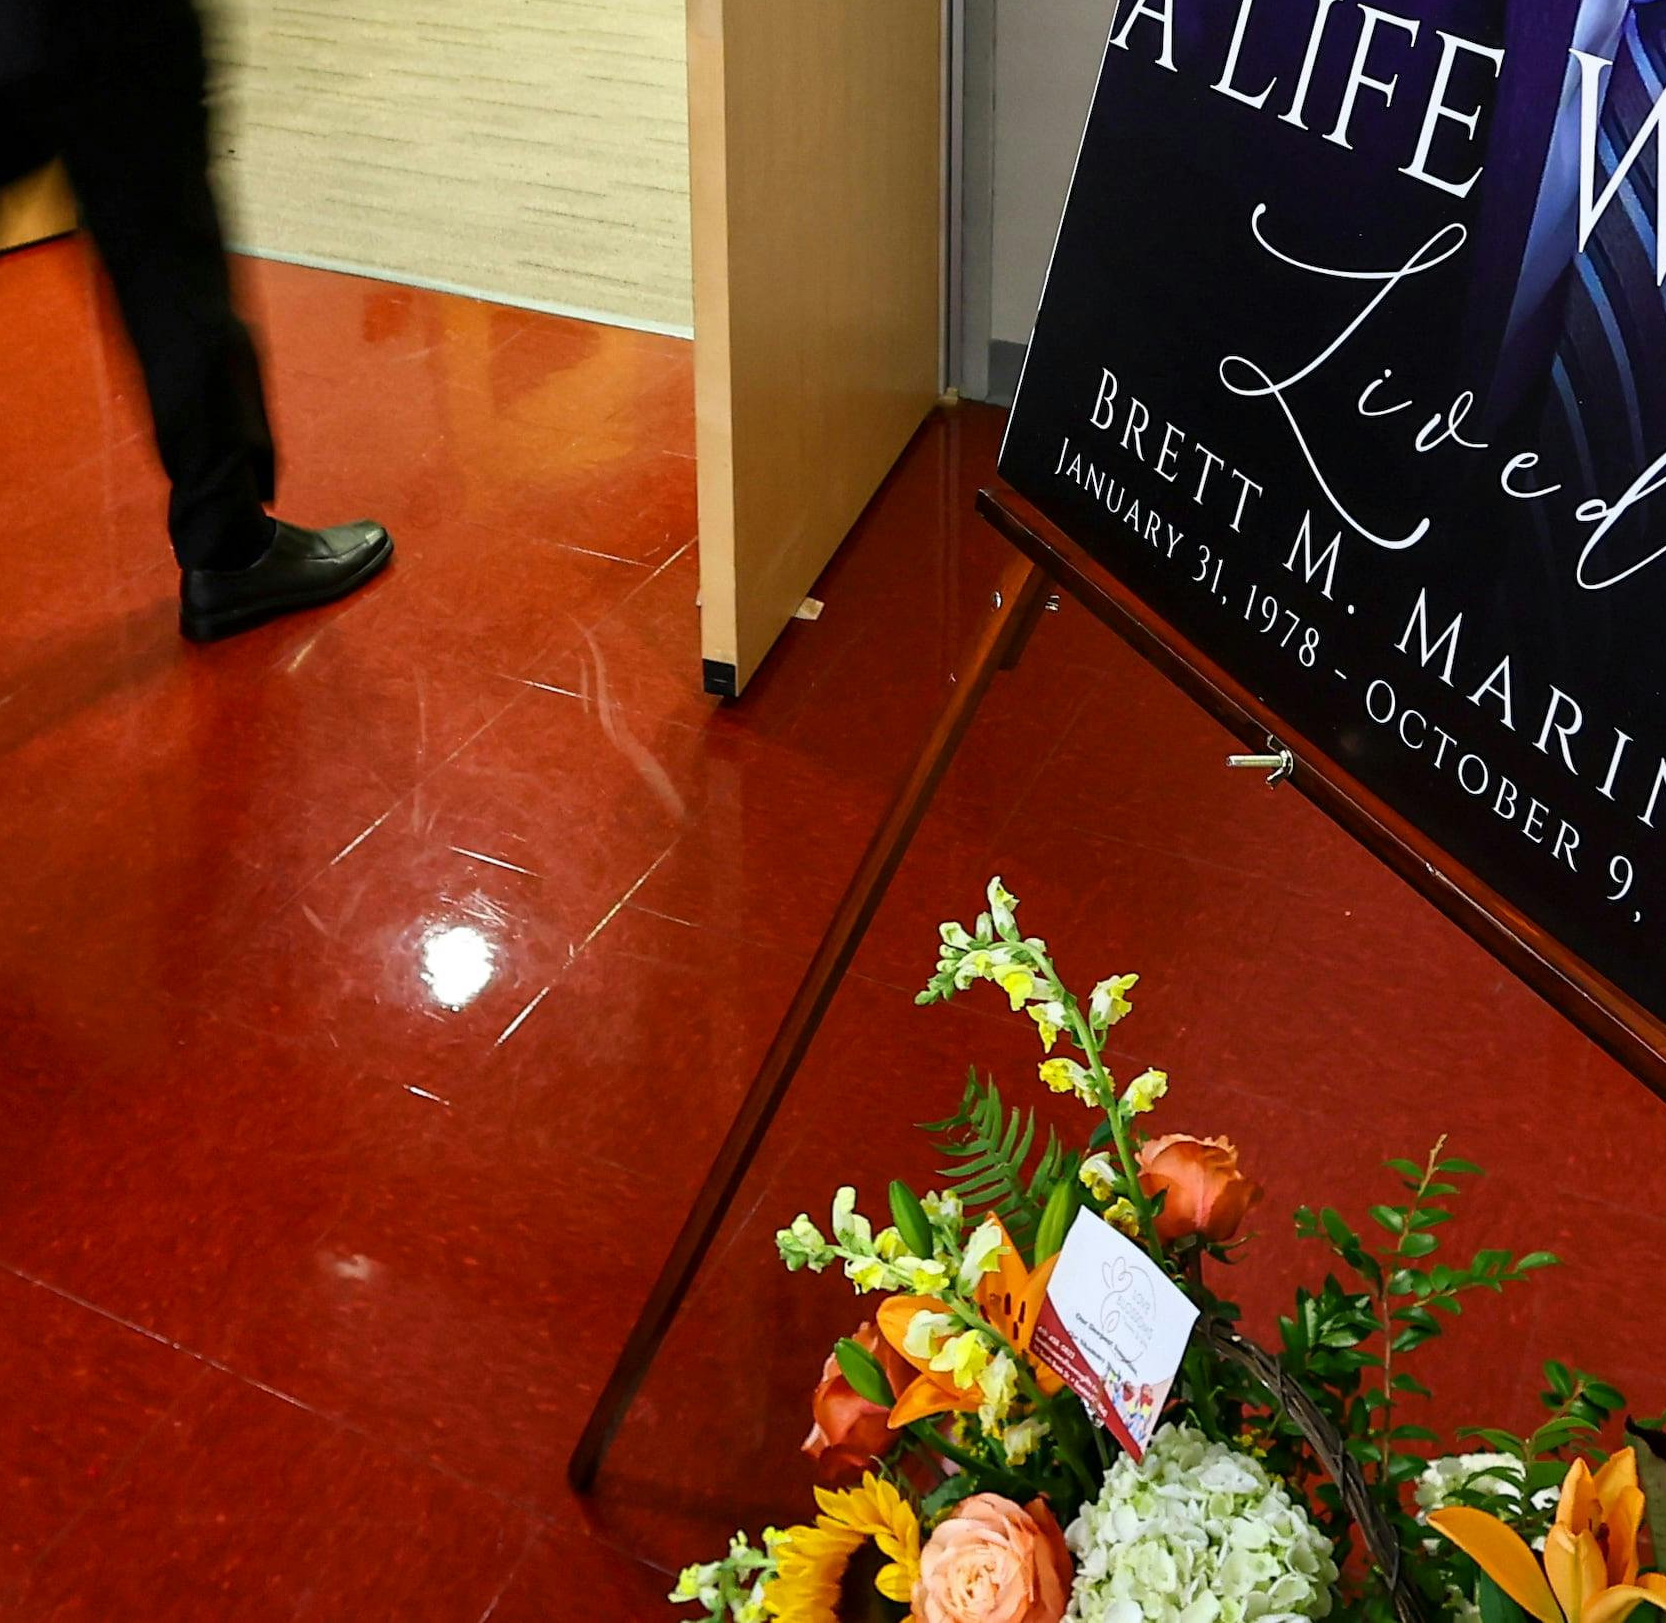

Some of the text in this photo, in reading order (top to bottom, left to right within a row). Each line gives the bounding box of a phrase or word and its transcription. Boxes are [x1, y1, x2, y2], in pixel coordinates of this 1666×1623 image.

[1089, 367, 1264, 534] BRETT
[1282, 509, 1355, 615] M.
[1054, 437, 1184, 559] JANUARY
[1191, 544, 1227, 606] 31,
[1243, 584, 1320, 668] 1978
[1365, 679, 1581, 873] OCTOBER
[1606, 855, 1645, 925] 9,
